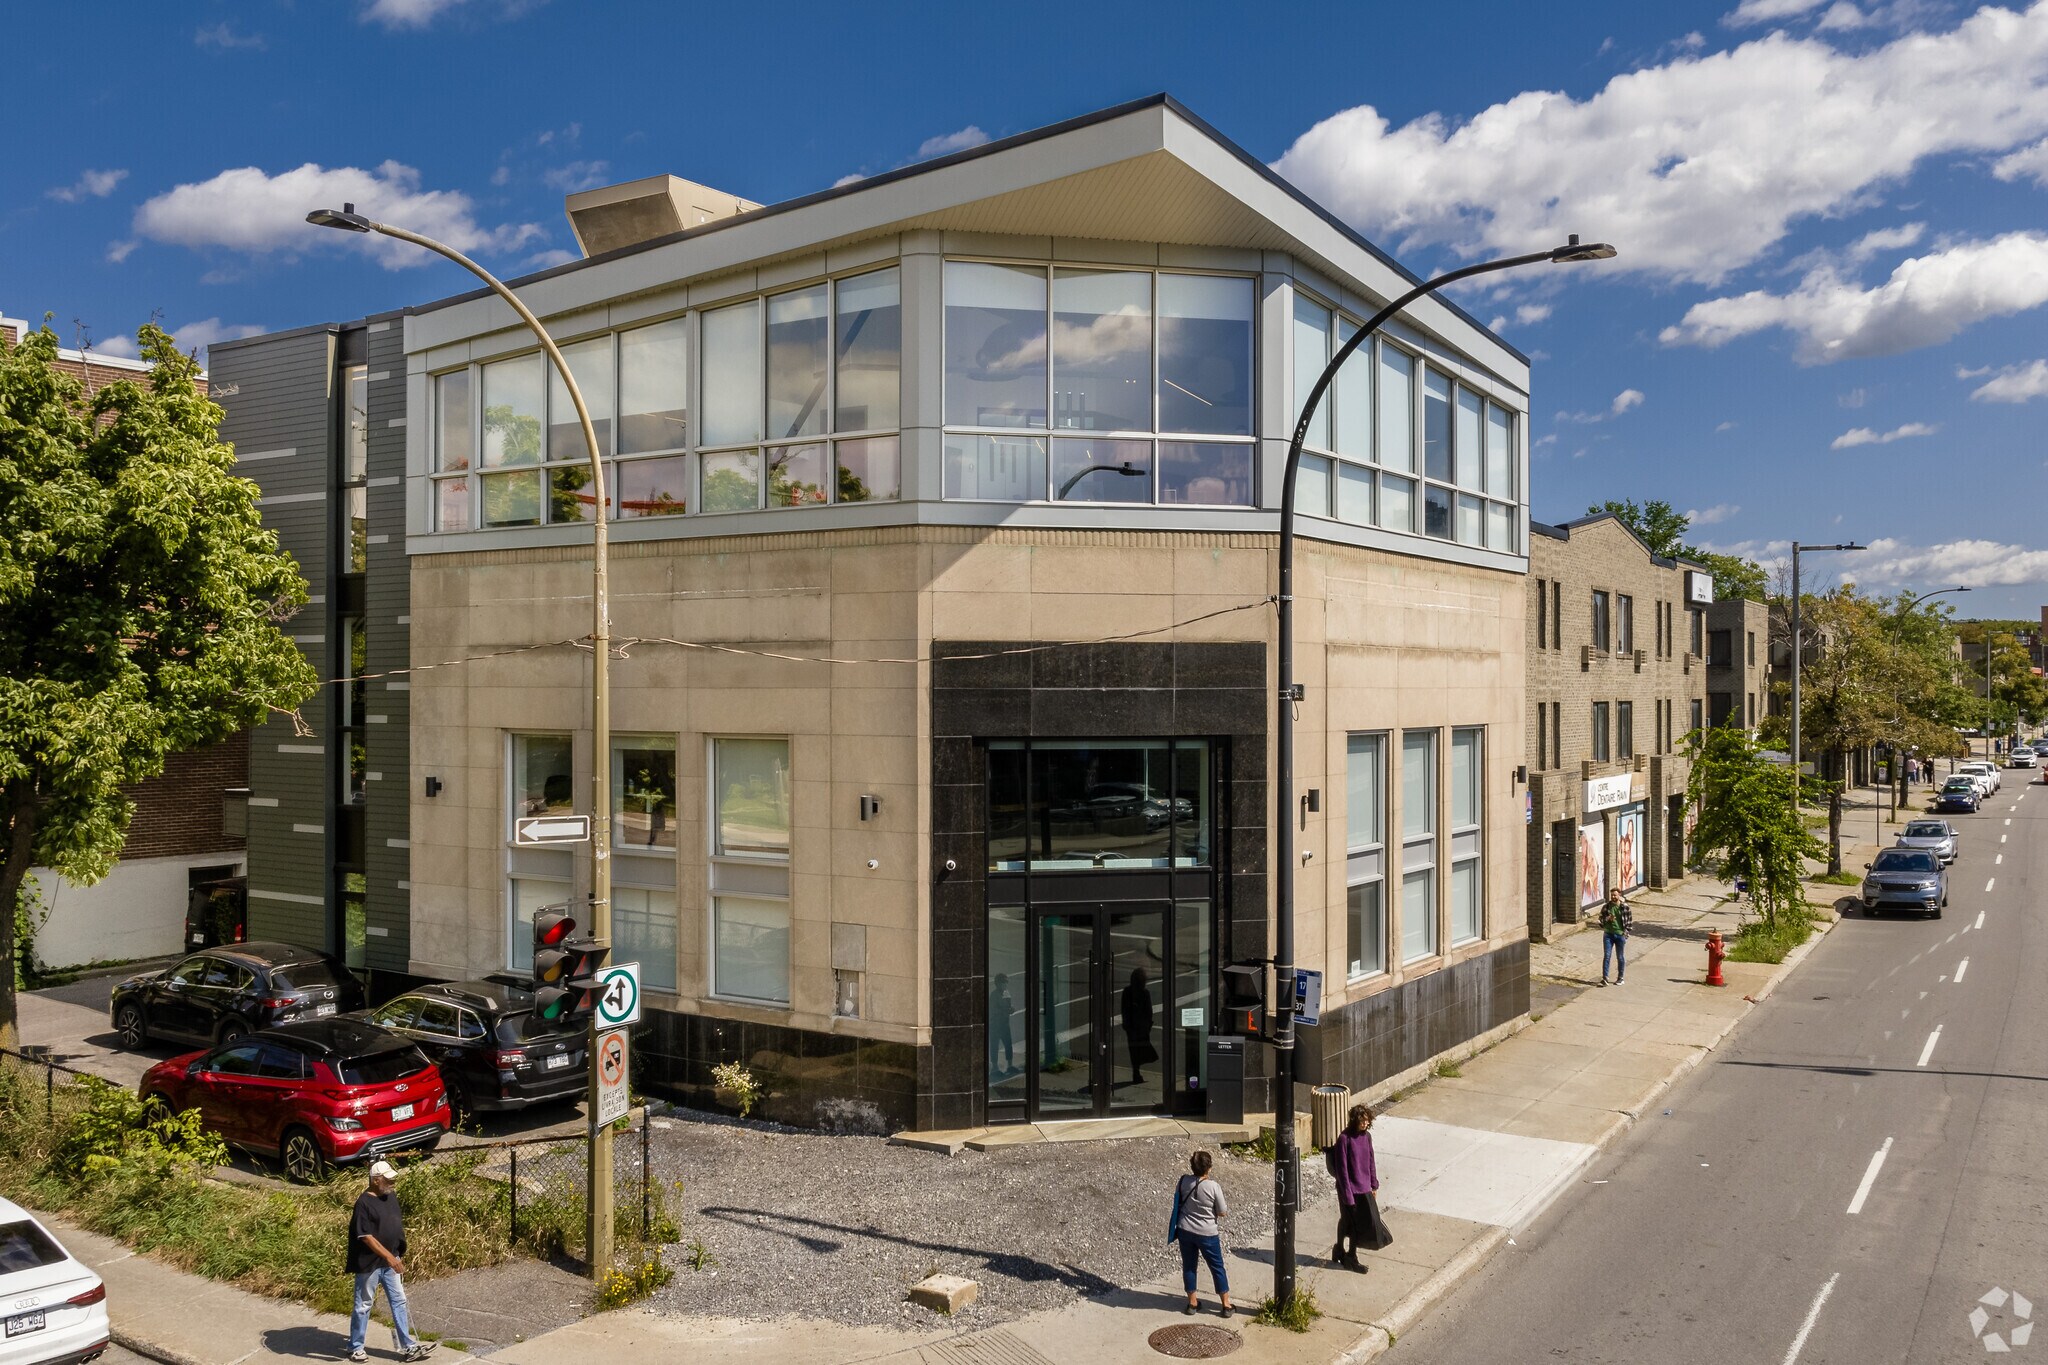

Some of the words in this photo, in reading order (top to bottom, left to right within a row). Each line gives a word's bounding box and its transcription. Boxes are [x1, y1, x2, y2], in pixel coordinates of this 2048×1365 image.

[1299, 981, 1307, 990] 17
[1295, 1002, 1305, 1011] 371
[605, 1103, 622, 1117] LOCALE
